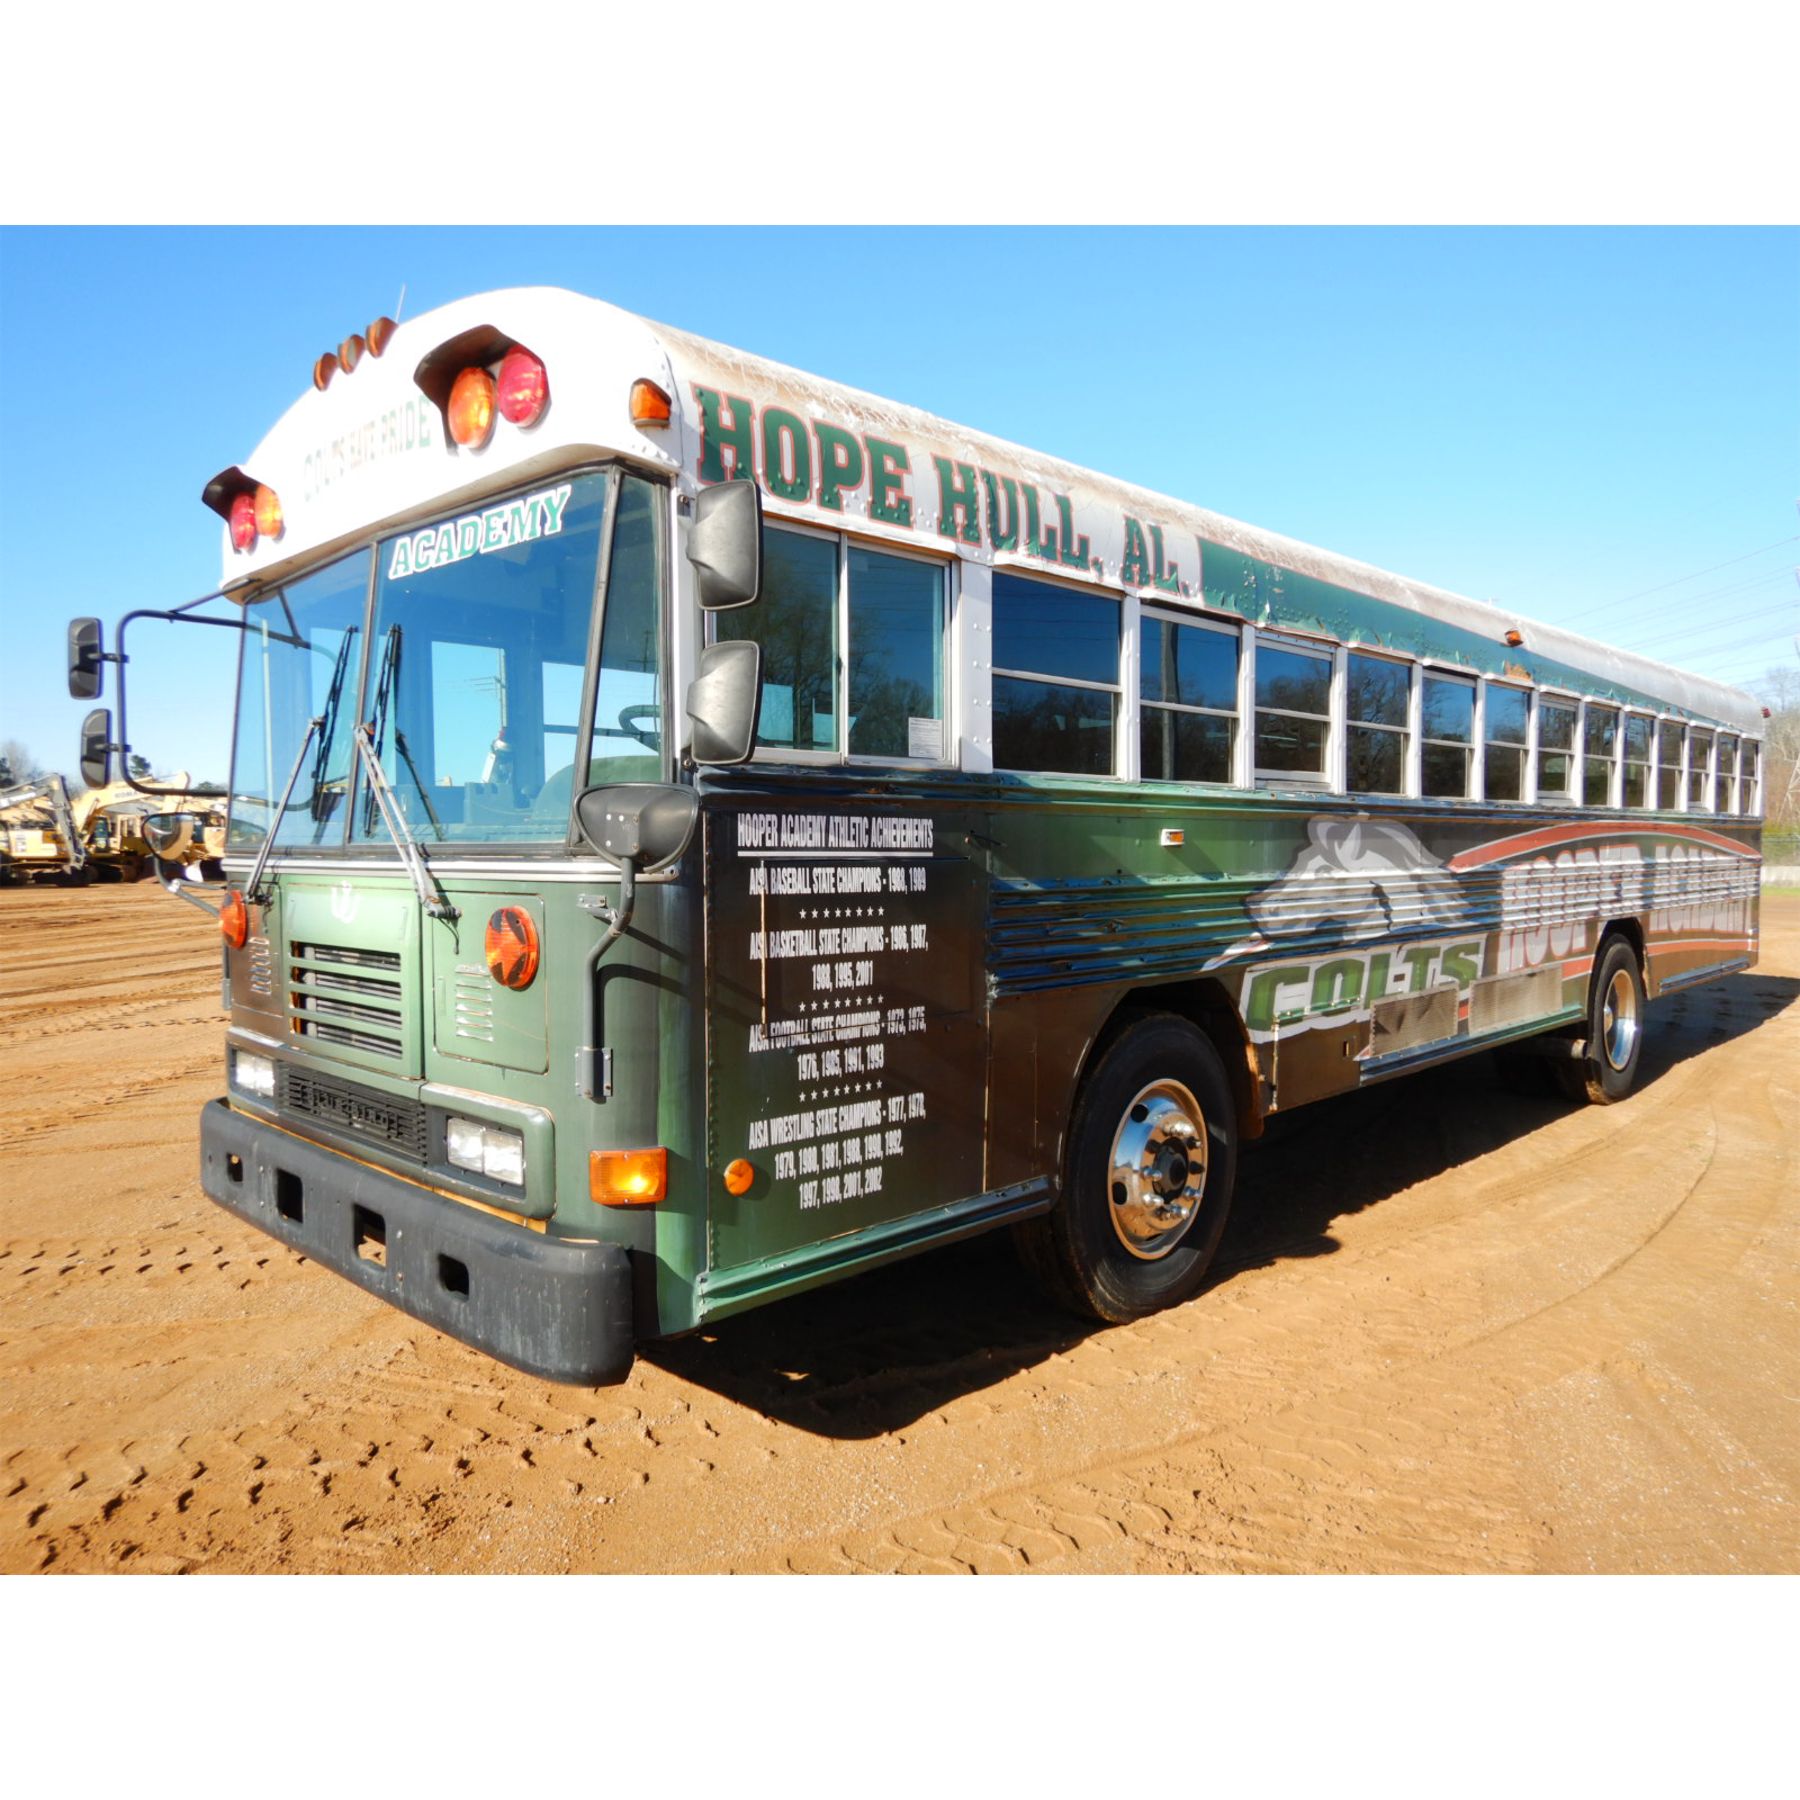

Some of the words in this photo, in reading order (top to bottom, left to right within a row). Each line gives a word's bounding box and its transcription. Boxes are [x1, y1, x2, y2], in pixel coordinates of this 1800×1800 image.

[690, 381, 916, 531] HOPE
[388, 484, 572, 579] ACADEMY
[737, 813, 778, 847] HOOPER
[780, 814, 827, 848] ACADEMY
[828, 815, 869, 848] ATHLETIC
[871, 816, 934, 849] ACHIEVEMENTS
[770, 867, 812, 895] BASEBALL
[812, 867, 836, 894] STATE
[836, 866, 882, 893] CHAMPIONS
[769, 929, 818, 958] BASKETBALL
[818, 927, 841, 955] STATE
[841, 925, 885, 953] CHAMPIONS
[855, 960, 874, 987] 2001
[1242, 936, 1484, 1040] COLTS
[769, 1017, 812, 1050] FOOTBALL
[811, 1014, 835, 1044] STATE
[835, 1009, 881, 1041] CHAMPIONS
[749, 1119, 769, 1150] AISA
[769, 1110, 815, 1146] WRESTLING
[815, 1105, 838, 1137] STATE
[837, 1099, 882, 1132] CHAMPIONS
